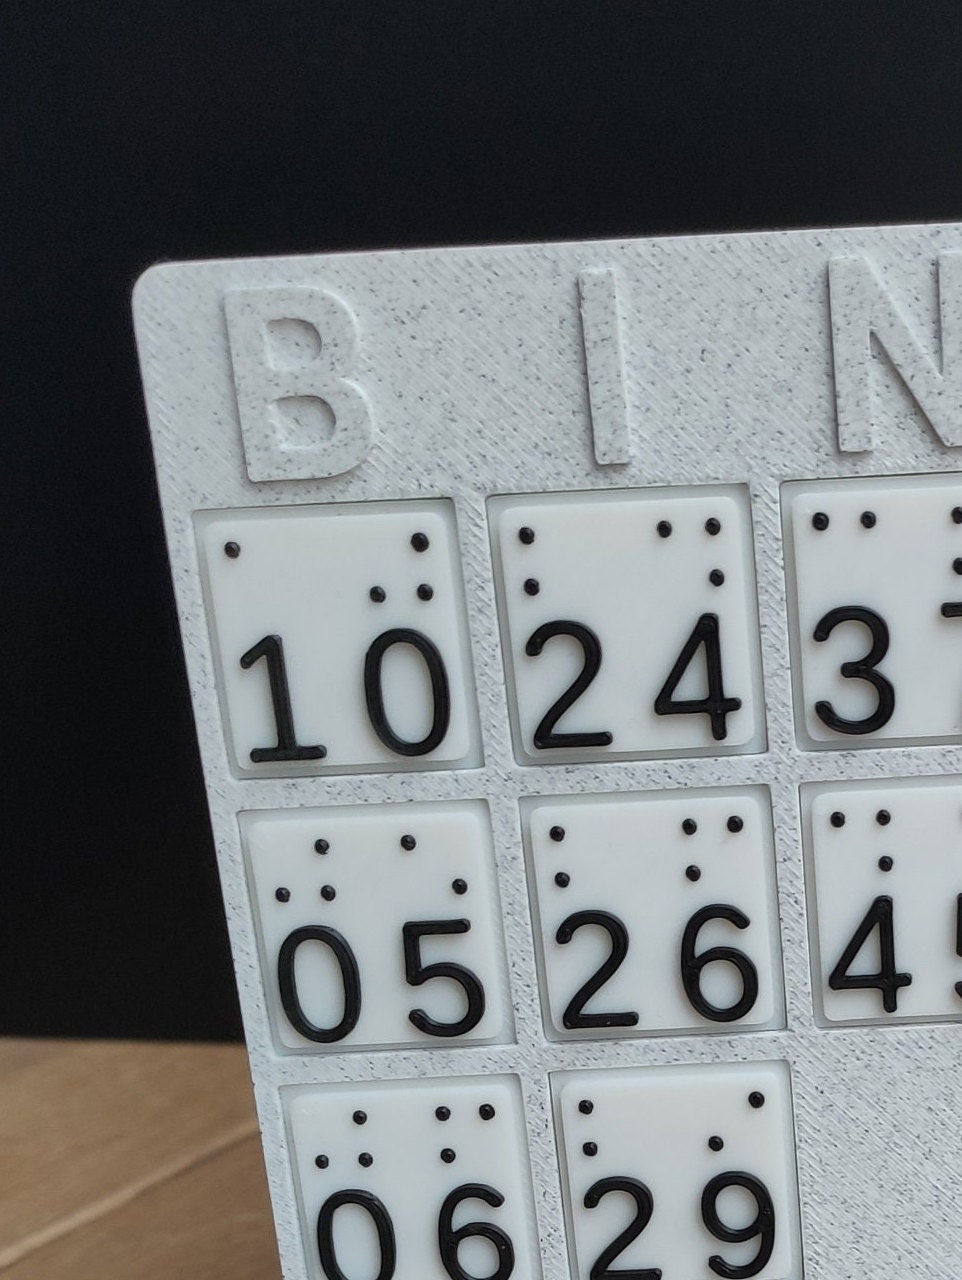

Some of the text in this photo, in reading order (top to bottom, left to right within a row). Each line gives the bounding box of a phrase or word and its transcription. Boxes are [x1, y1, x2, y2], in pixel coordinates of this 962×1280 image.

[238, 626, 452, 765] 10
[523, 611, 743, 752] 24
[276, 917, 487, 1045] 05
[554, 902, 760, 1032] 26
